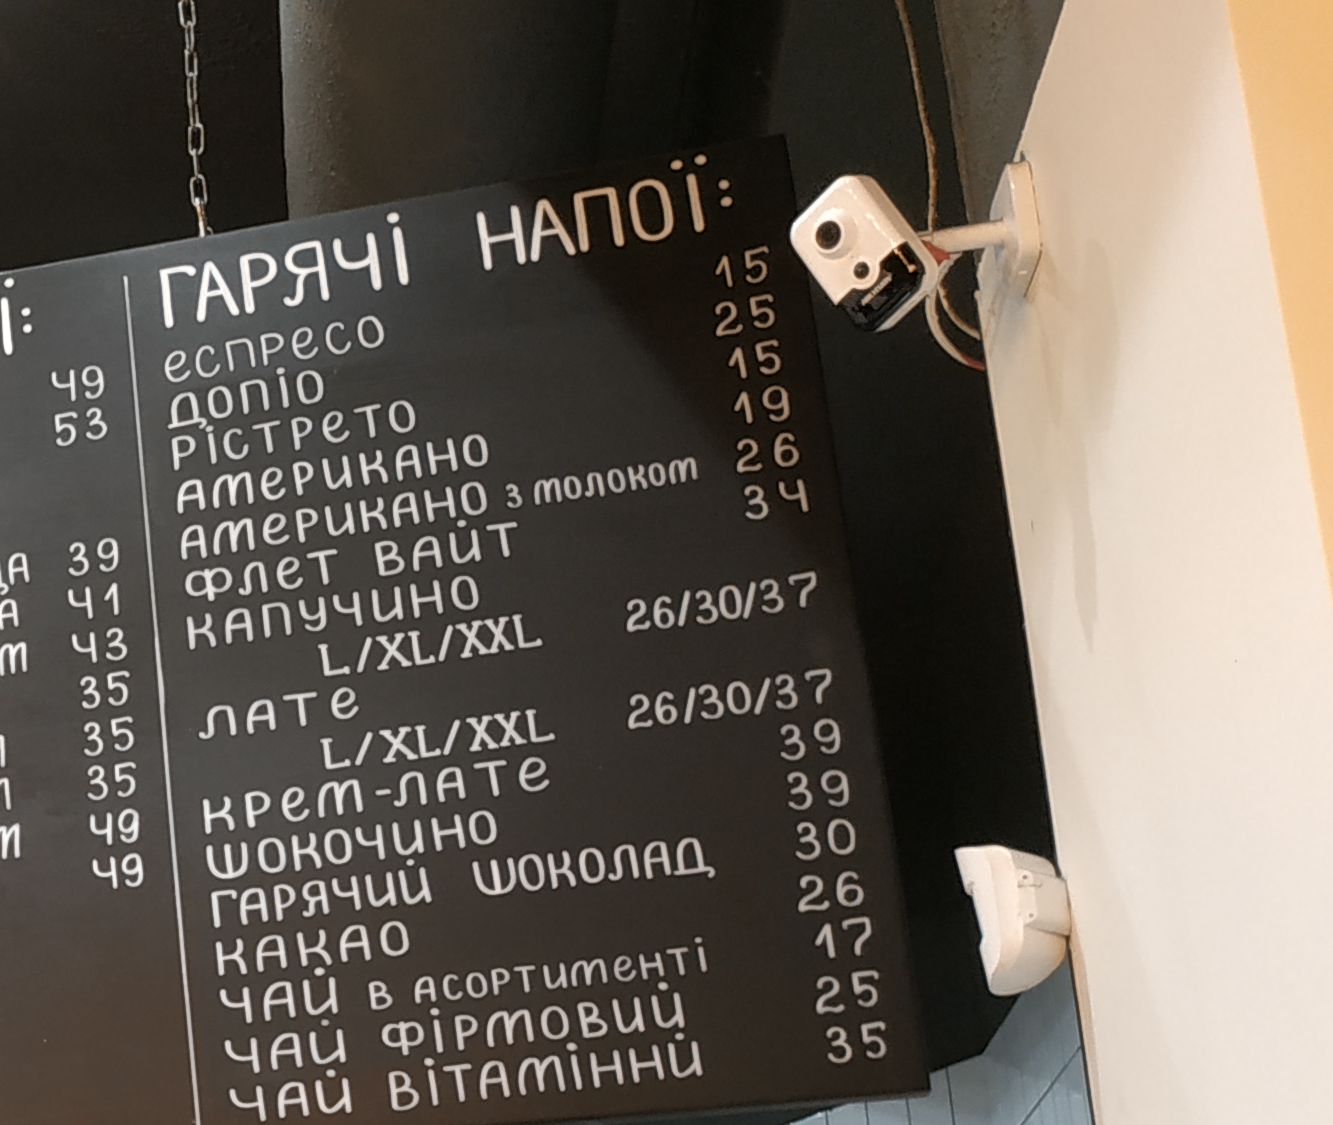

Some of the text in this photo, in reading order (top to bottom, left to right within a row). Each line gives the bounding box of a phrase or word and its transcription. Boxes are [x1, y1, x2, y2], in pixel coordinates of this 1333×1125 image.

[159, 213, 408, 328] ГАРЯЧІ
[165, 246, 769, 382] ЕСПРЕСО 15
[52, 366, 104, 401] 49
[168, 294, 774, 429] ДОПІО 25
[55, 408, 107, 446] 53
[172, 401, 415, 470] РІСТРЕТО
[178, 386, 789, 513] АМЕРИКАНО 19
[534, 458, 697, 504] МОЛОКОМ
[69, 538, 118, 576] 39
[185, 480, 808, 601] ФЛЕТ ВАЙТ 34
[68, 583, 119, 619] 41
[187, 576, 479, 649] КАПУЧИНО
[318, 571, 816, 676] L/XL/XXL 26/30/37
[628, 669, 832, 729] 26/30/37
[203, 719, 840, 834] КРЕМ-ЛАТЕ 39
[206, 811, 497, 879] ШОКОЧИНО
[211, 819, 855, 928] ГАРЯЧИЙ ШОКОЛАД 30
[216, 921, 409, 976] КАКАО
[220, 917, 871, 1023] ЧАЙ АСОРТИМЕНТІ 17
[382, 982, 684, 1055] ФІРМОВИЙ
[230, 1070, 351, 1121] ЧАЙ
